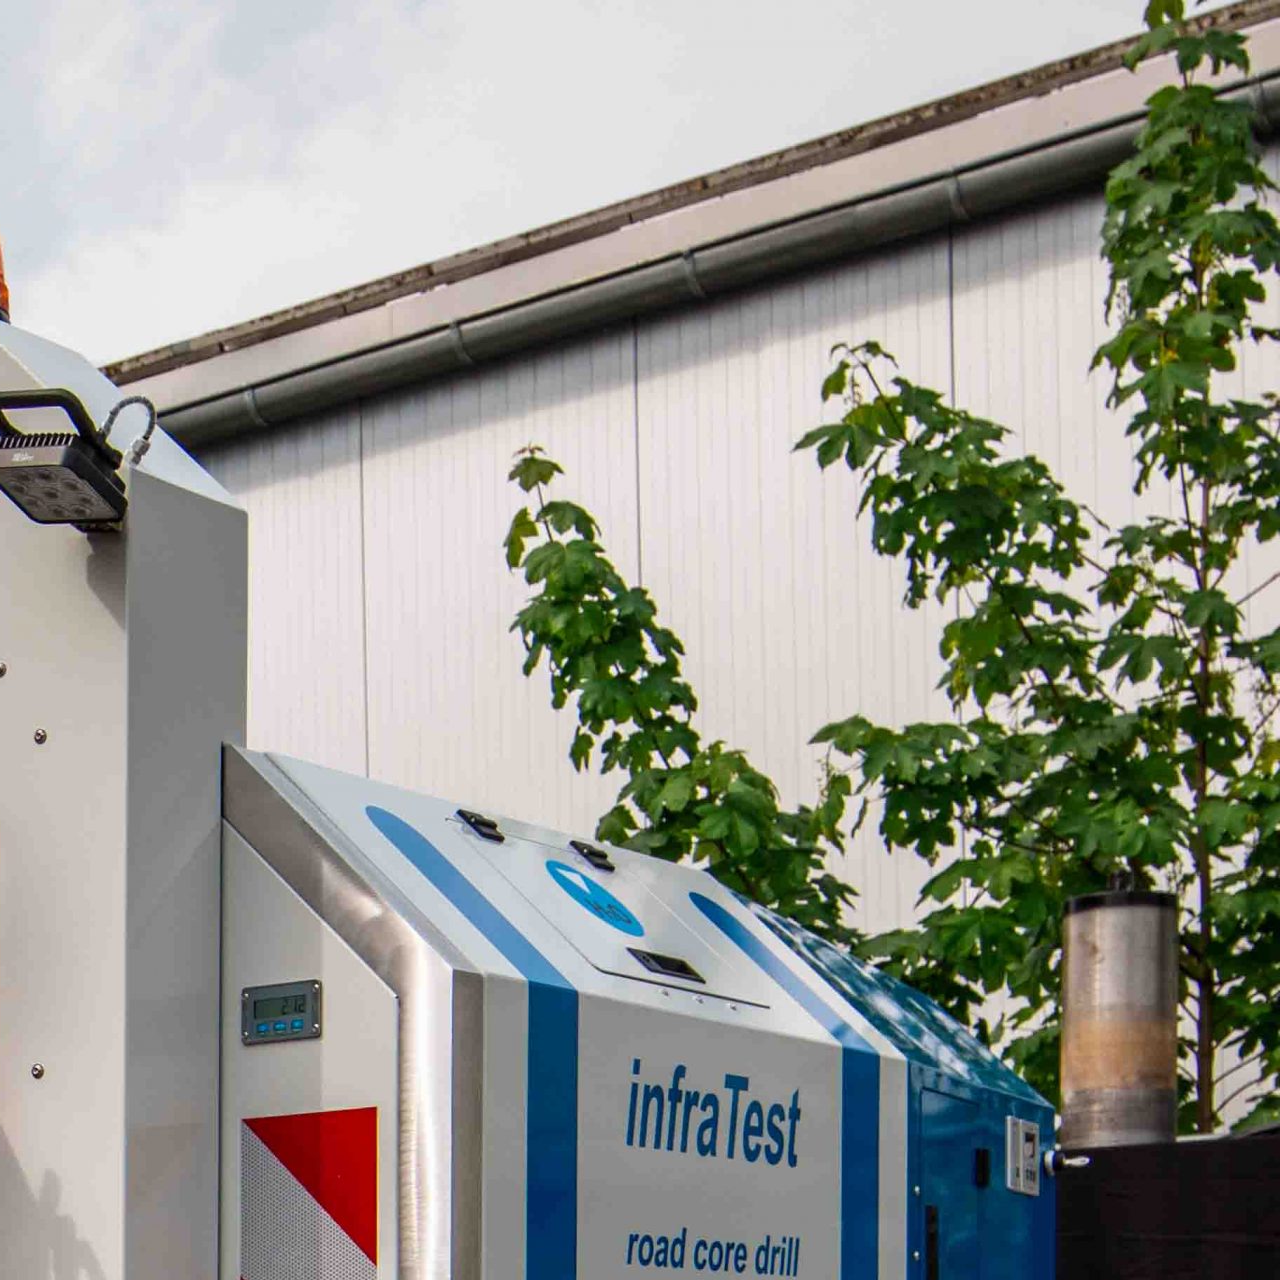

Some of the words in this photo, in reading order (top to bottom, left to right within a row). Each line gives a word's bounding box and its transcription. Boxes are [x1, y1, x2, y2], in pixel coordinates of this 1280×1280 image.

[626, 1058, 801, 1168] infraTest
[626, 1227, 687, 1268] road
[693, 1238, 747, 1274] core
[755, 1235, 800, 1277] drill
